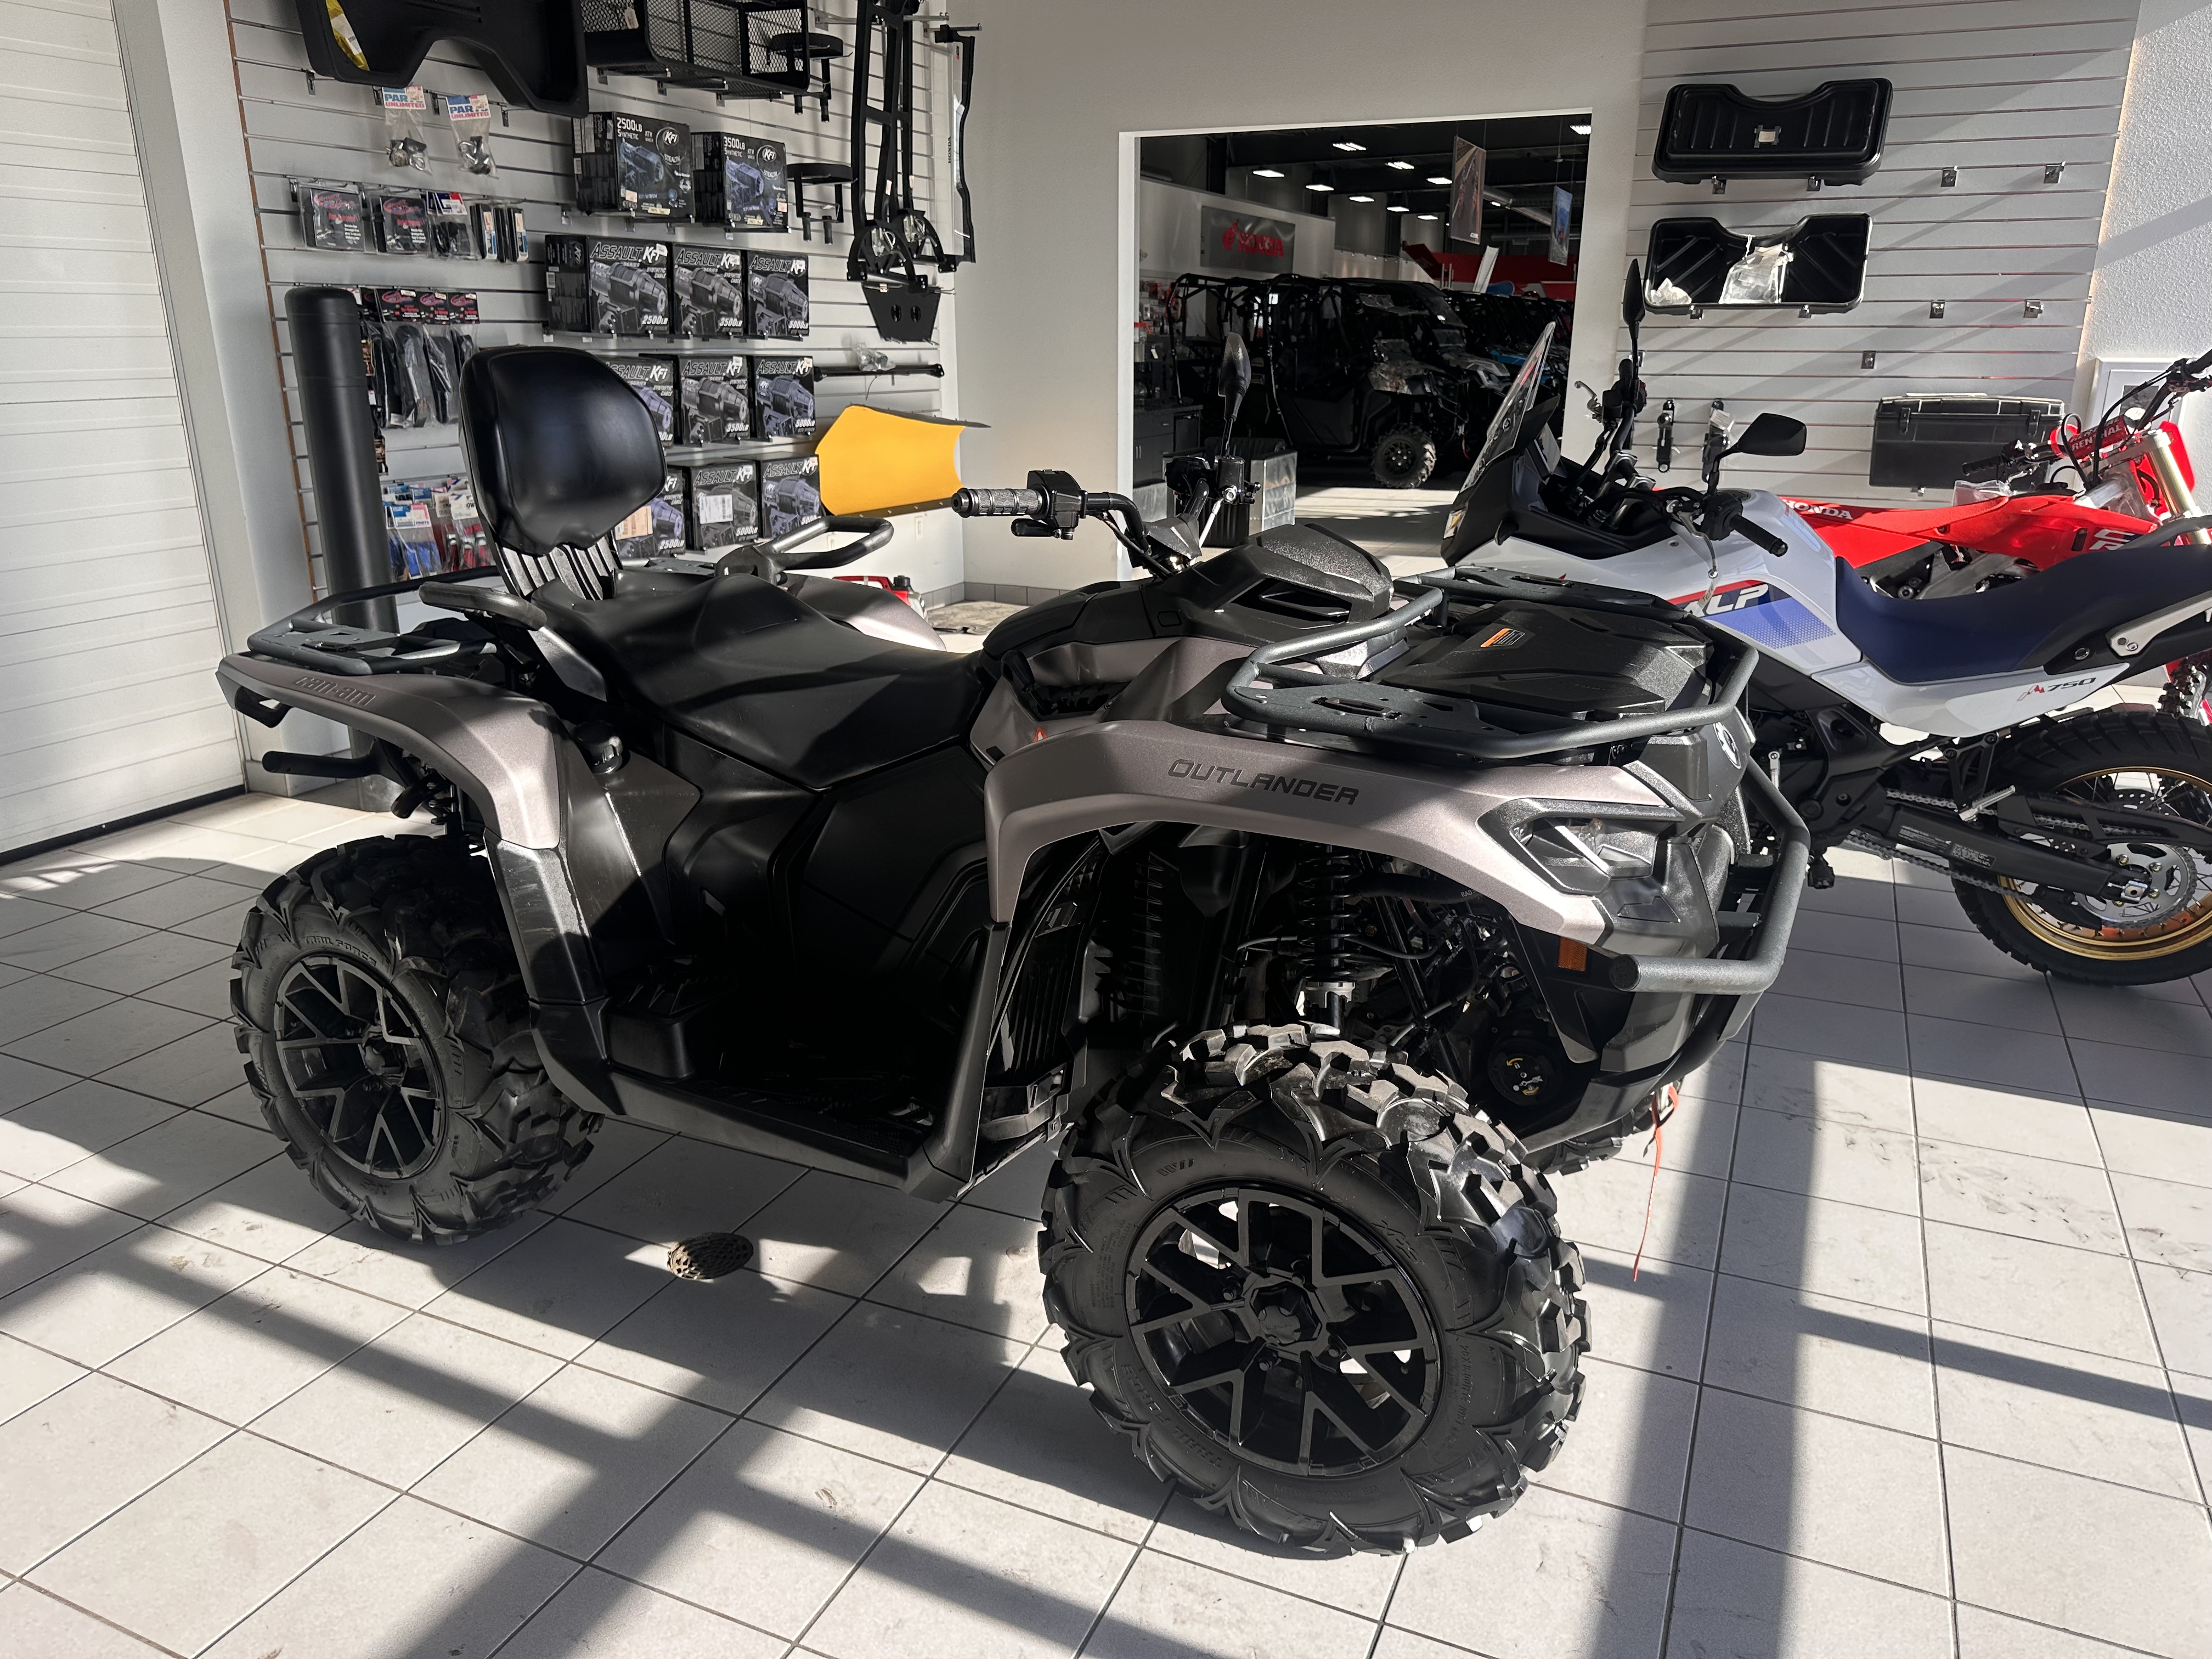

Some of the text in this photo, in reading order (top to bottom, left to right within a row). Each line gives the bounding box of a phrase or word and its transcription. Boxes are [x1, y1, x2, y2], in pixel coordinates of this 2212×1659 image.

[384, 94, 423, 103] PAR
[449, 105, 488, 114] PAR
[617, 117, 642, 132] 2500LB
[617, 129, 639, 140] SYNTHETIC
[724, 136, 746, 150] 3500LB
[664, 153, 680, 163] STEALTH
[590, 241, 644, 261] ASSAULT
[1238, 233, 1284, 257] HONDA
[675, 248, 722, 266] ASSAULT
[749, 255, 792, 273] ASSAULT
[642, 314, 668, 325] 2500LB
[719, 317, 743, 327] 3500LB
[788, 320, 809, 329] 5000LB
[606, 362, 651, 380] SSAULT
[681, 360, 727, 376] ASSAULT
[755, 359, 797, 375] ASSAULT
[726, 422, 749, 432] 3500LB
[795, 418, 816, 428] 5000LB
[2072, 425, 2122, 451] RENHAL
[763, 462, 803, 478] ASSAULT
[693, 470, 737, 486] ASSAULT
[736, 526, 758, 537] 5000LB
[659, 538, 685, 550] 2500LB
[1168, 759, 1359, 805] OUTLANDER
